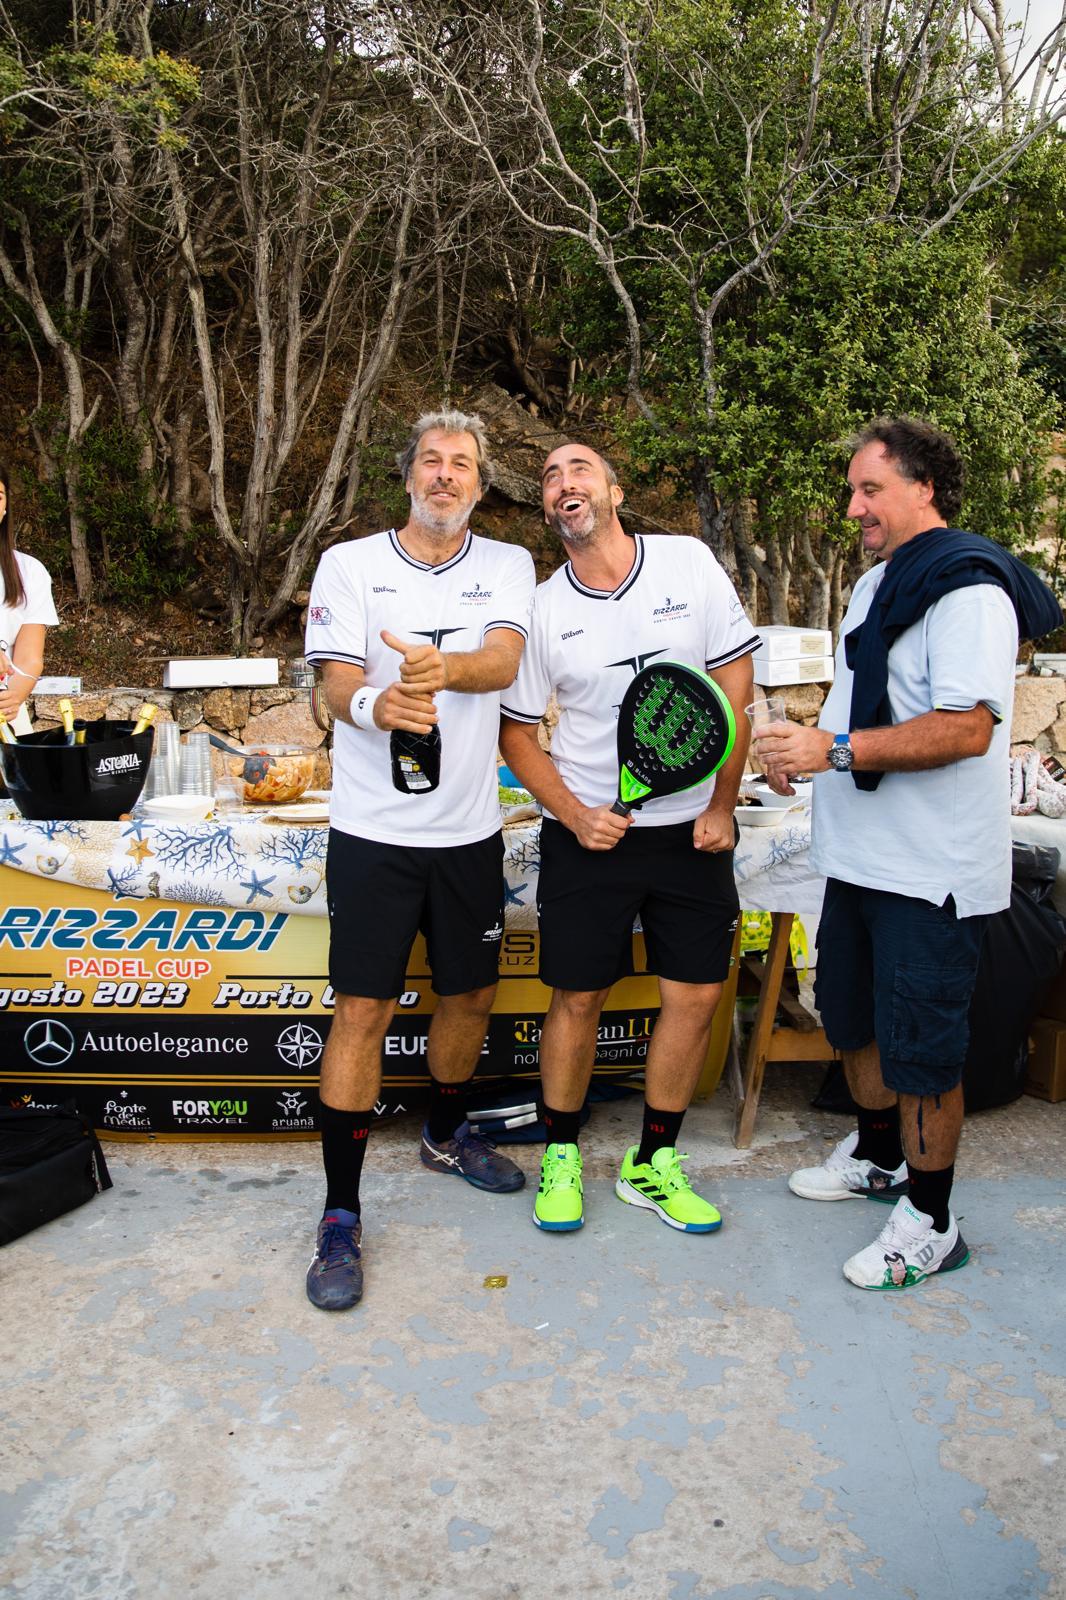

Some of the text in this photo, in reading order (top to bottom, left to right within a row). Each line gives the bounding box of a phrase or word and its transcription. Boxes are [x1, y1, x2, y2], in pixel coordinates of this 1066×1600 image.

[652, 603, 688, 616] RIZZARDI
[561, 628, 584, 640] Wilson
[95, 753, 142, 774] ASTORIA
[635, 767, 652, 785] BLADE
[0, 906, 289, 951] RIZZARDI
[66, 957, 212, 980] PADEL CUP
[0, 981, 84, 1010] gosto
[91, 981, 191, 1008] 2023
[212, 982, 313, 1009] Porto
[80, 1031, 249, 1058] Autoelegance
[104, 1100, 147, 1114] fonte
[272, 1116, 314, 1127] aruanã
